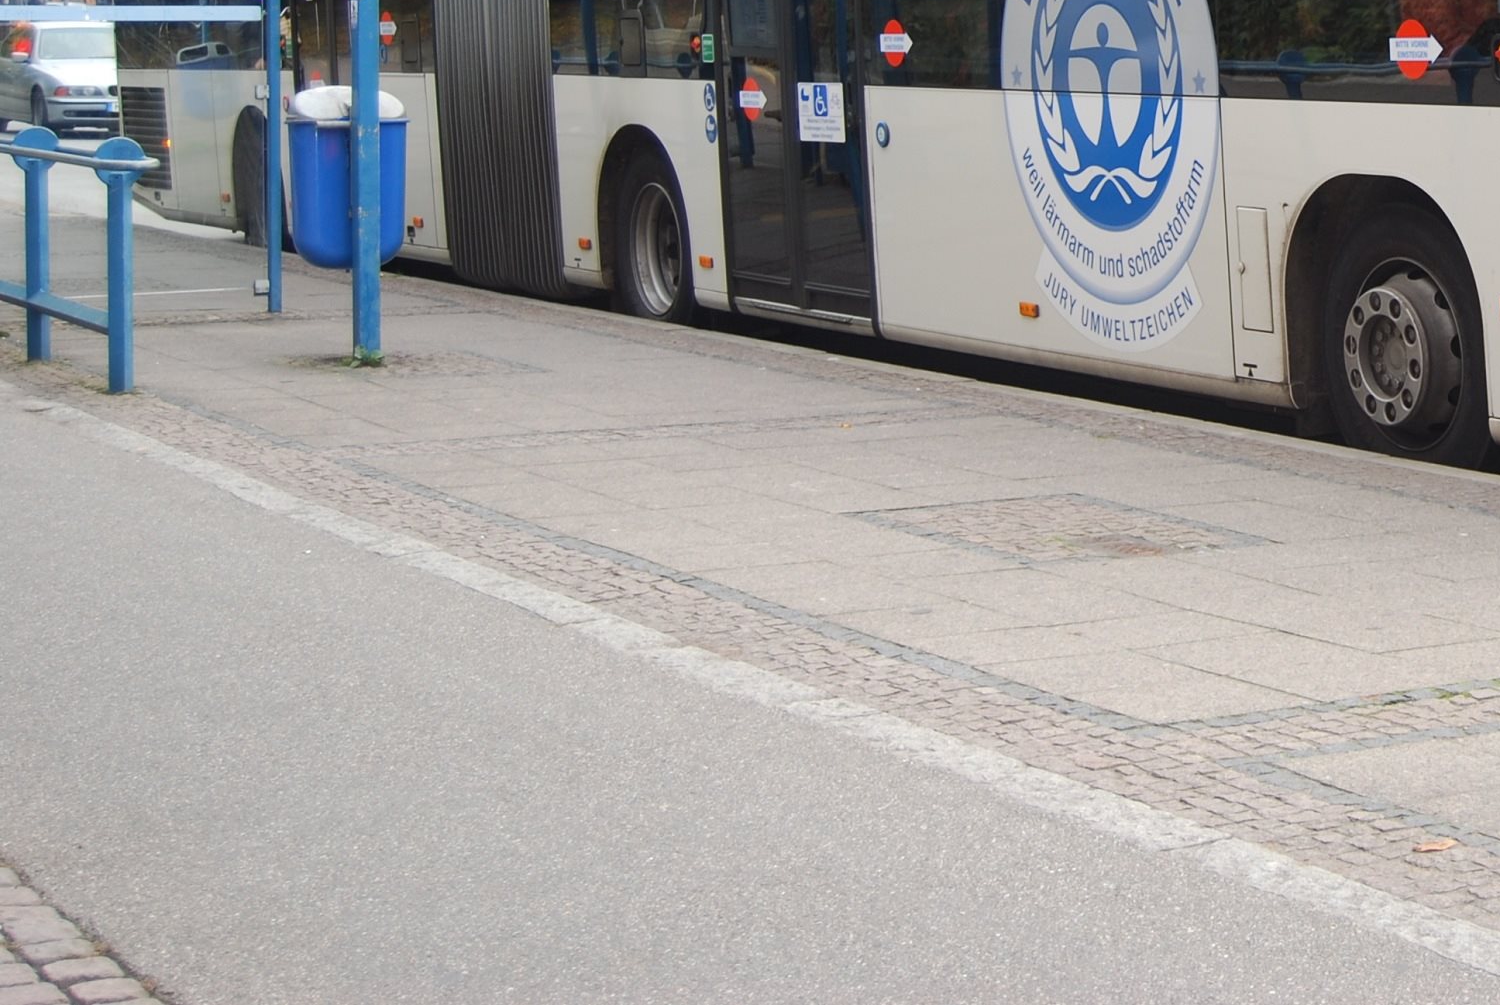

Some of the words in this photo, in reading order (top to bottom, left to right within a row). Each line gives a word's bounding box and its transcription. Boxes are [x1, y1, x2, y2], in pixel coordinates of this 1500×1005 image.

[1022, 147, 1046, 199] weil
[1042, 193, 1095, 269] lärmarm
[1099, 254, 1124, 278] und
[1128, 159, 1204, 277] schadstoffarm
[1043, 272, 1077, 316] JURY
[1081, 286, 1194, 342] UMWELTZEICHEN
